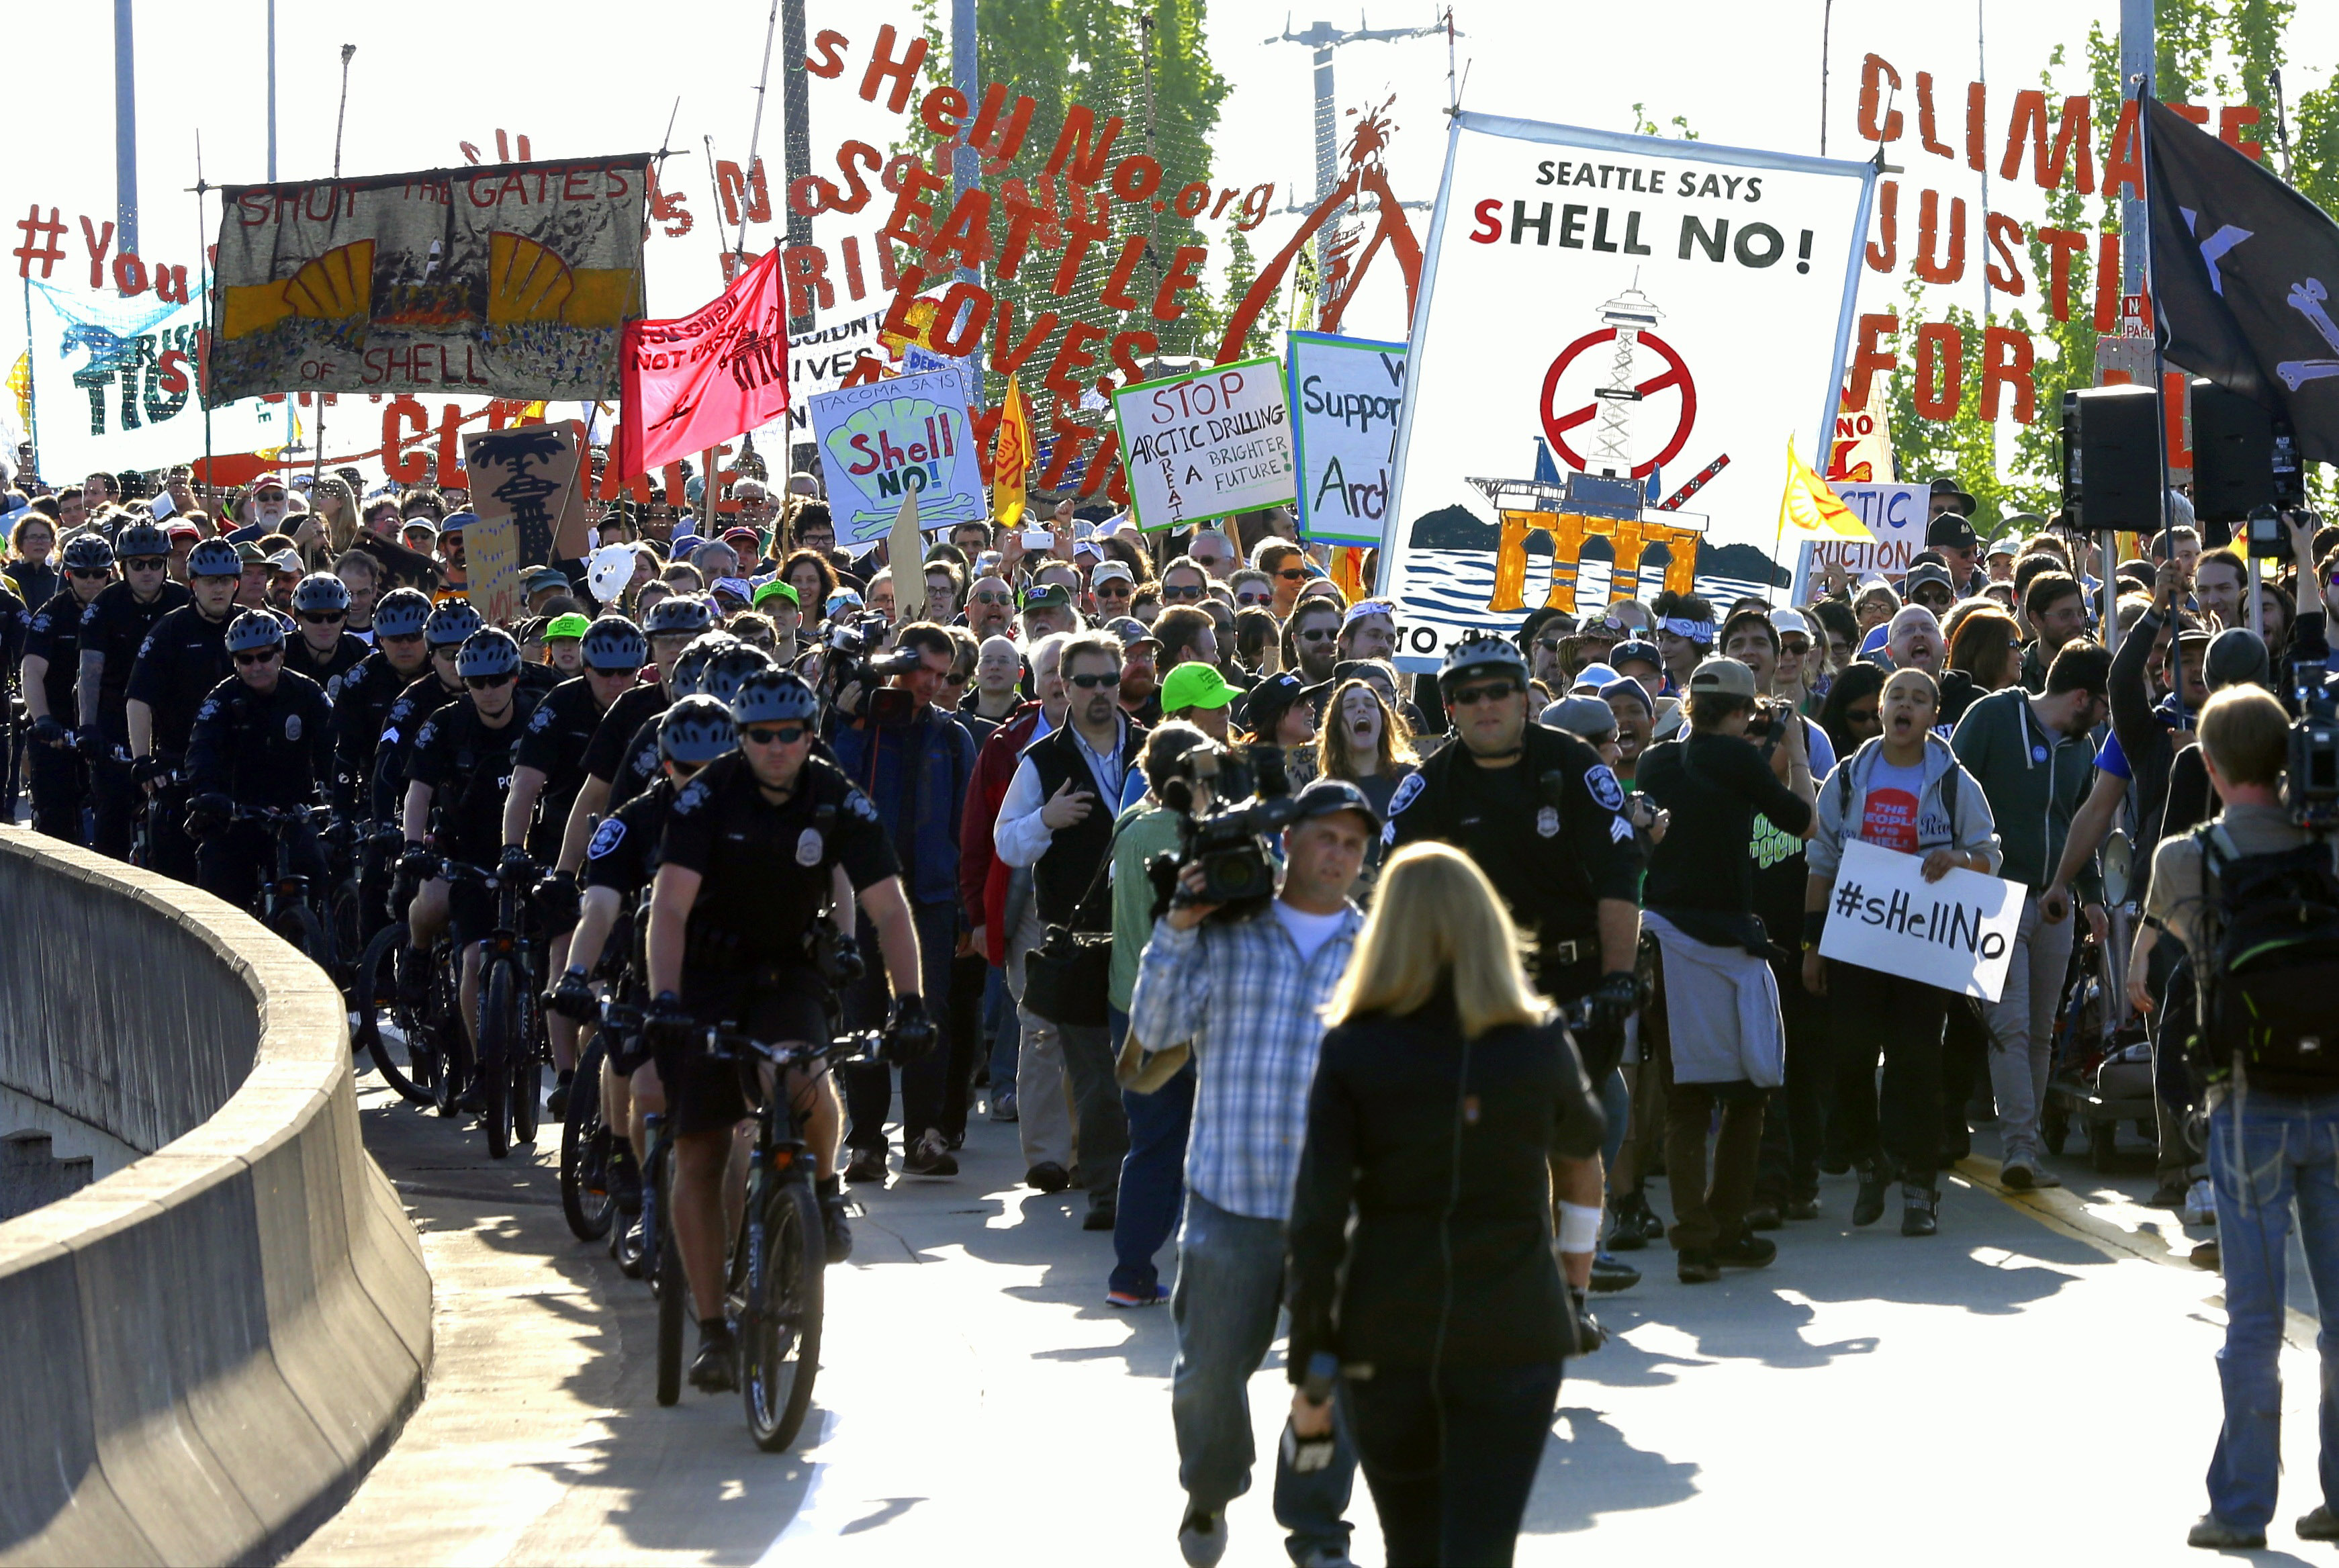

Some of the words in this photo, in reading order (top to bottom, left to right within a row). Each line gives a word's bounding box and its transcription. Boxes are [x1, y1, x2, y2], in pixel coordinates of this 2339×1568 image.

[238, 183, 369, 226] SHUT
[404, 177, 452, 205] THE
[469, 161, 631, 209] GATES
[1536, 160, 1664, 195] SEATTLE
[1678, 171, 1763, 203] SAYS
[1469, 199, 1651, 256] SHELL
[1678, 214, 1813, 275] NO!
[1865, 181, 2122, 334] JUSTI
[301, 360, 336, 380] OF
[361, 343, 489, 385] SHELL
[632, 349, 686, 371] NOT
[1846, 313, 2035, 426] FOR
[814, 382, 902, 414] TACOMA
[908, 373, 956, 392] SAYS
[1152, 371, 1244, 424] STOP
[1302, 375, 1403, 434] Suppor
[847, 412, 954, 475] Shell
[1130, 424, 1205, 468] ARCTIC
[1207, 404, 1286, 443] DRILLING
[1835, 414, 1874, 439] NO
[1206, 436, 1287, 467] BRIGHTER
[877, 461, 942, 498] NO!
[1185, 463, 1203, 485] A
[1314, 455, 1390, 520] Arct
[497, 774, 513, 790] PO
[1864, 812, 1917, 827] EOPL
[1874, 802, 1909, 815] THE
[1836, 881, 2005, 959] #sHellNo
